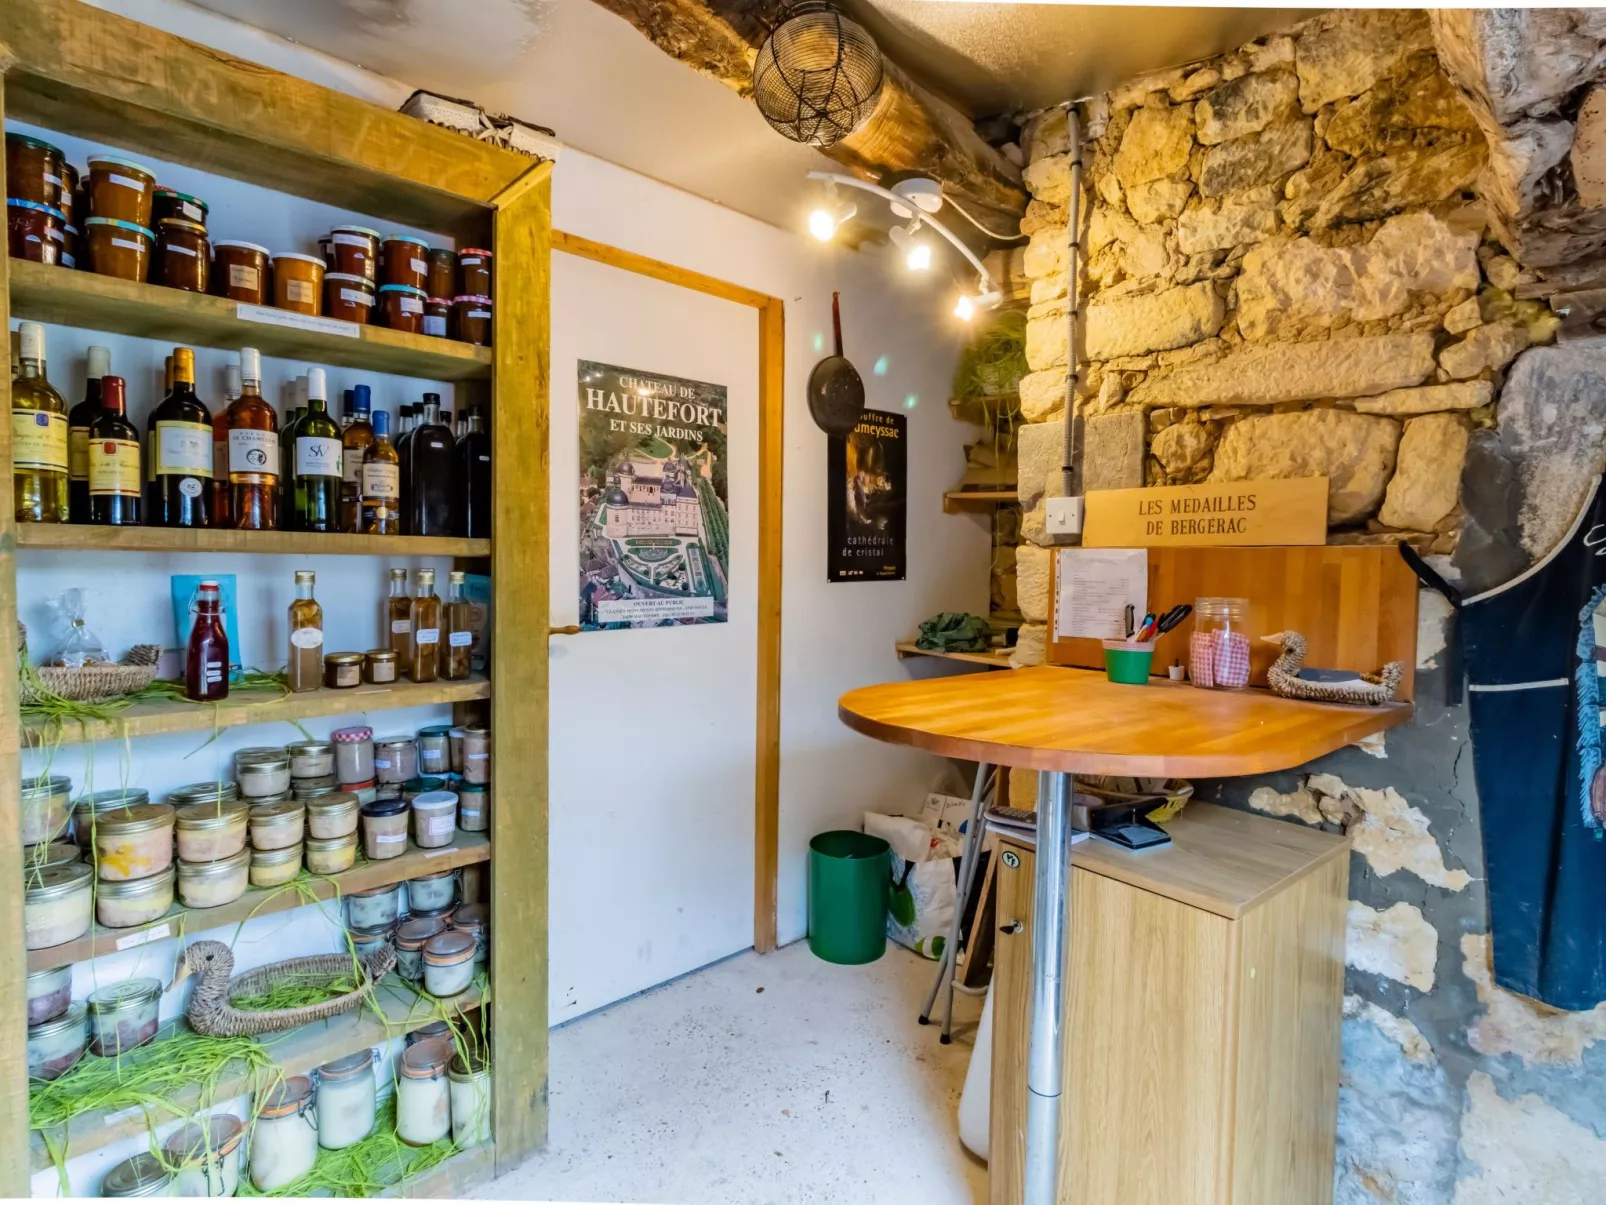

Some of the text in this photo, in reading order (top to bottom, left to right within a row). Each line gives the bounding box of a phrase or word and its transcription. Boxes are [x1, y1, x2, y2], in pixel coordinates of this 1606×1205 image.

[619, 376, 696, 399] CHATEAU DE
[586, 388, 722, 427] HAUTEFORT
[610, 419, 703, 442] ET SES JARDINS
[886, 416, 894, 424] de
[1139, 494, 1256, 515] LES MEDAILLES
[1146, 518, 1246, 535] DE BERGERAC
[842, 547, 884, 557] de cristal
